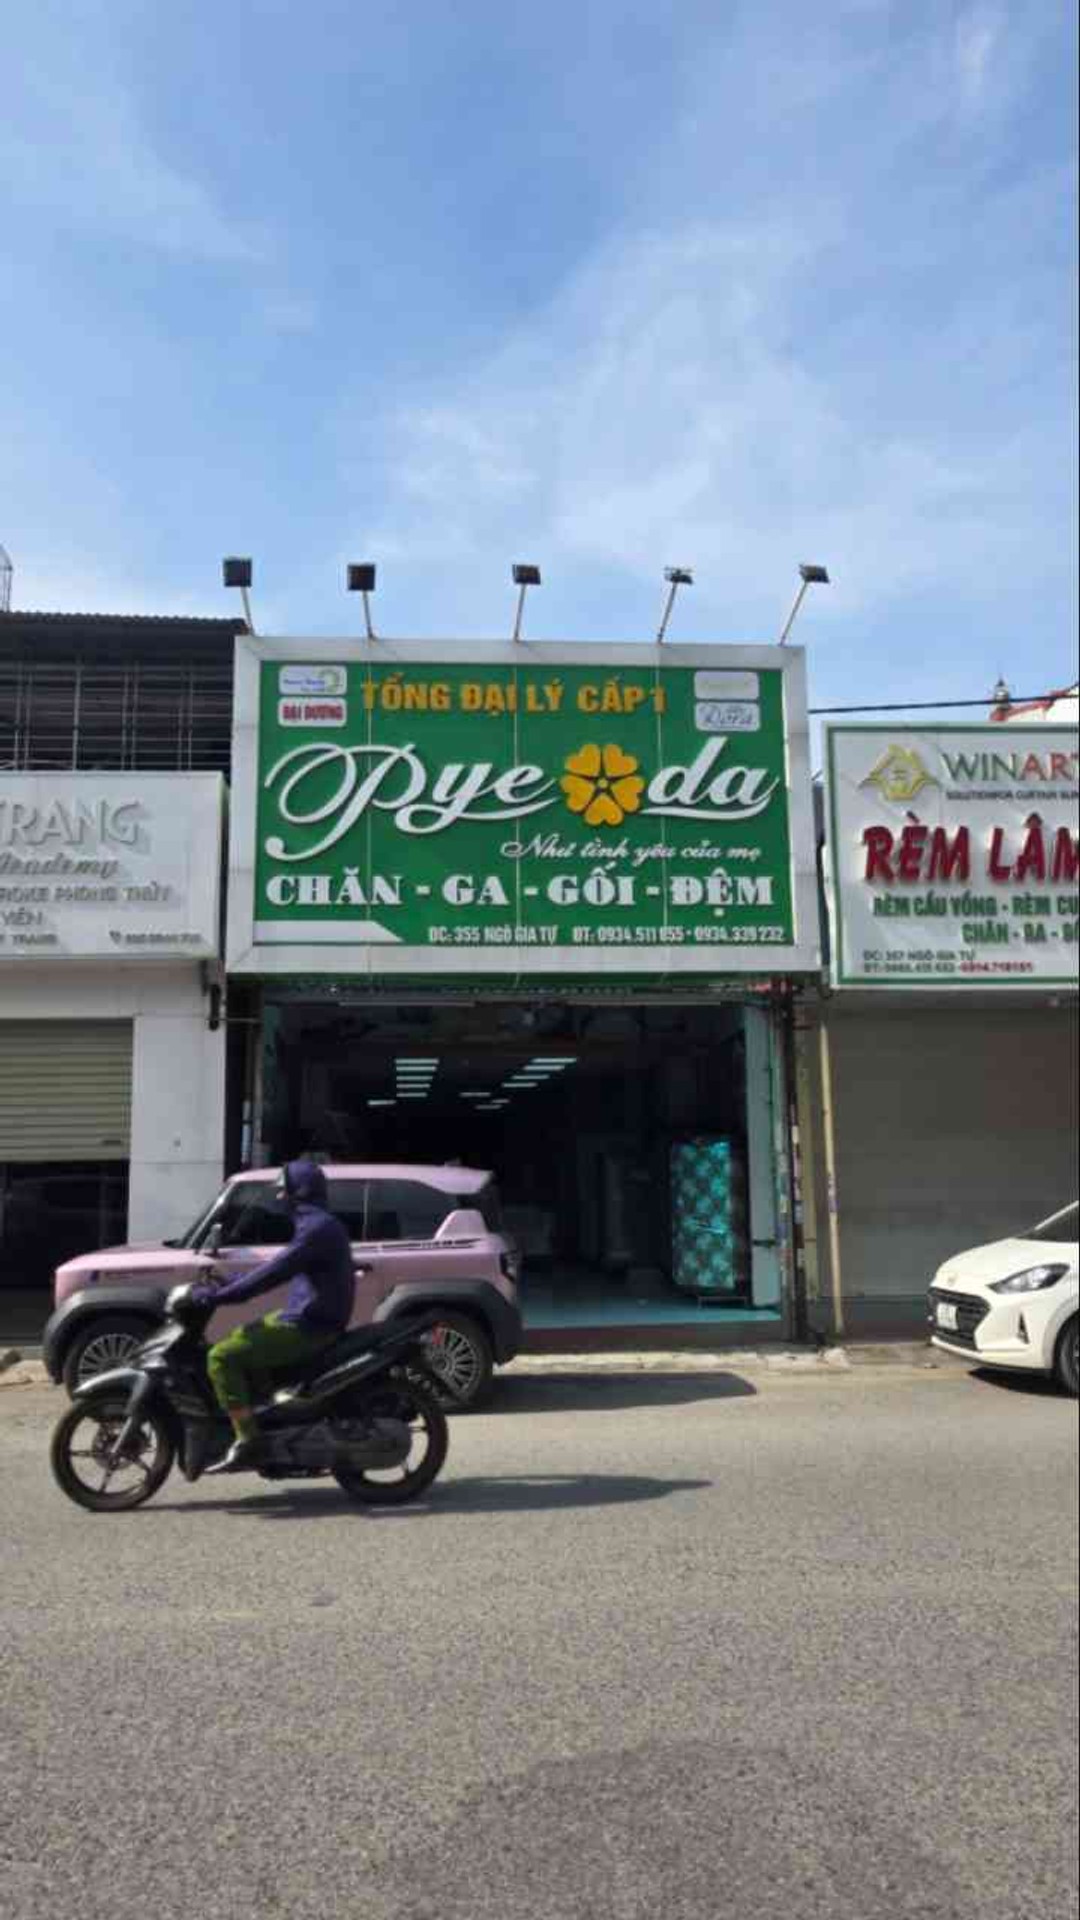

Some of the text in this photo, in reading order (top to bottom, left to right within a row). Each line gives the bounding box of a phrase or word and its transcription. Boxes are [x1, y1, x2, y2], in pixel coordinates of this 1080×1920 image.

[460, 682, 518, 716] ĐẠI
[526, 678, 563, 713] LÝ
[577, 675, 643, 713] CẤP
[651, 686, 666, 713] 1
[0, 799, 140, 847] RANG
[499, 833, 763, 868] Như tình yêu của mẹ
[862, 811, 1078, 885] RÈM LÂM
[264, 867, 403, 906] CHĂN
[442, 873, 510, 906] GA
[546, 861, 637, 906] GỐI
[669, 866, 775, 917] ĐỆM
[454, 925, 481, 943] 355
[515, 925, 538, 943] GIA
[539, 923, 559, 946] TỰ
